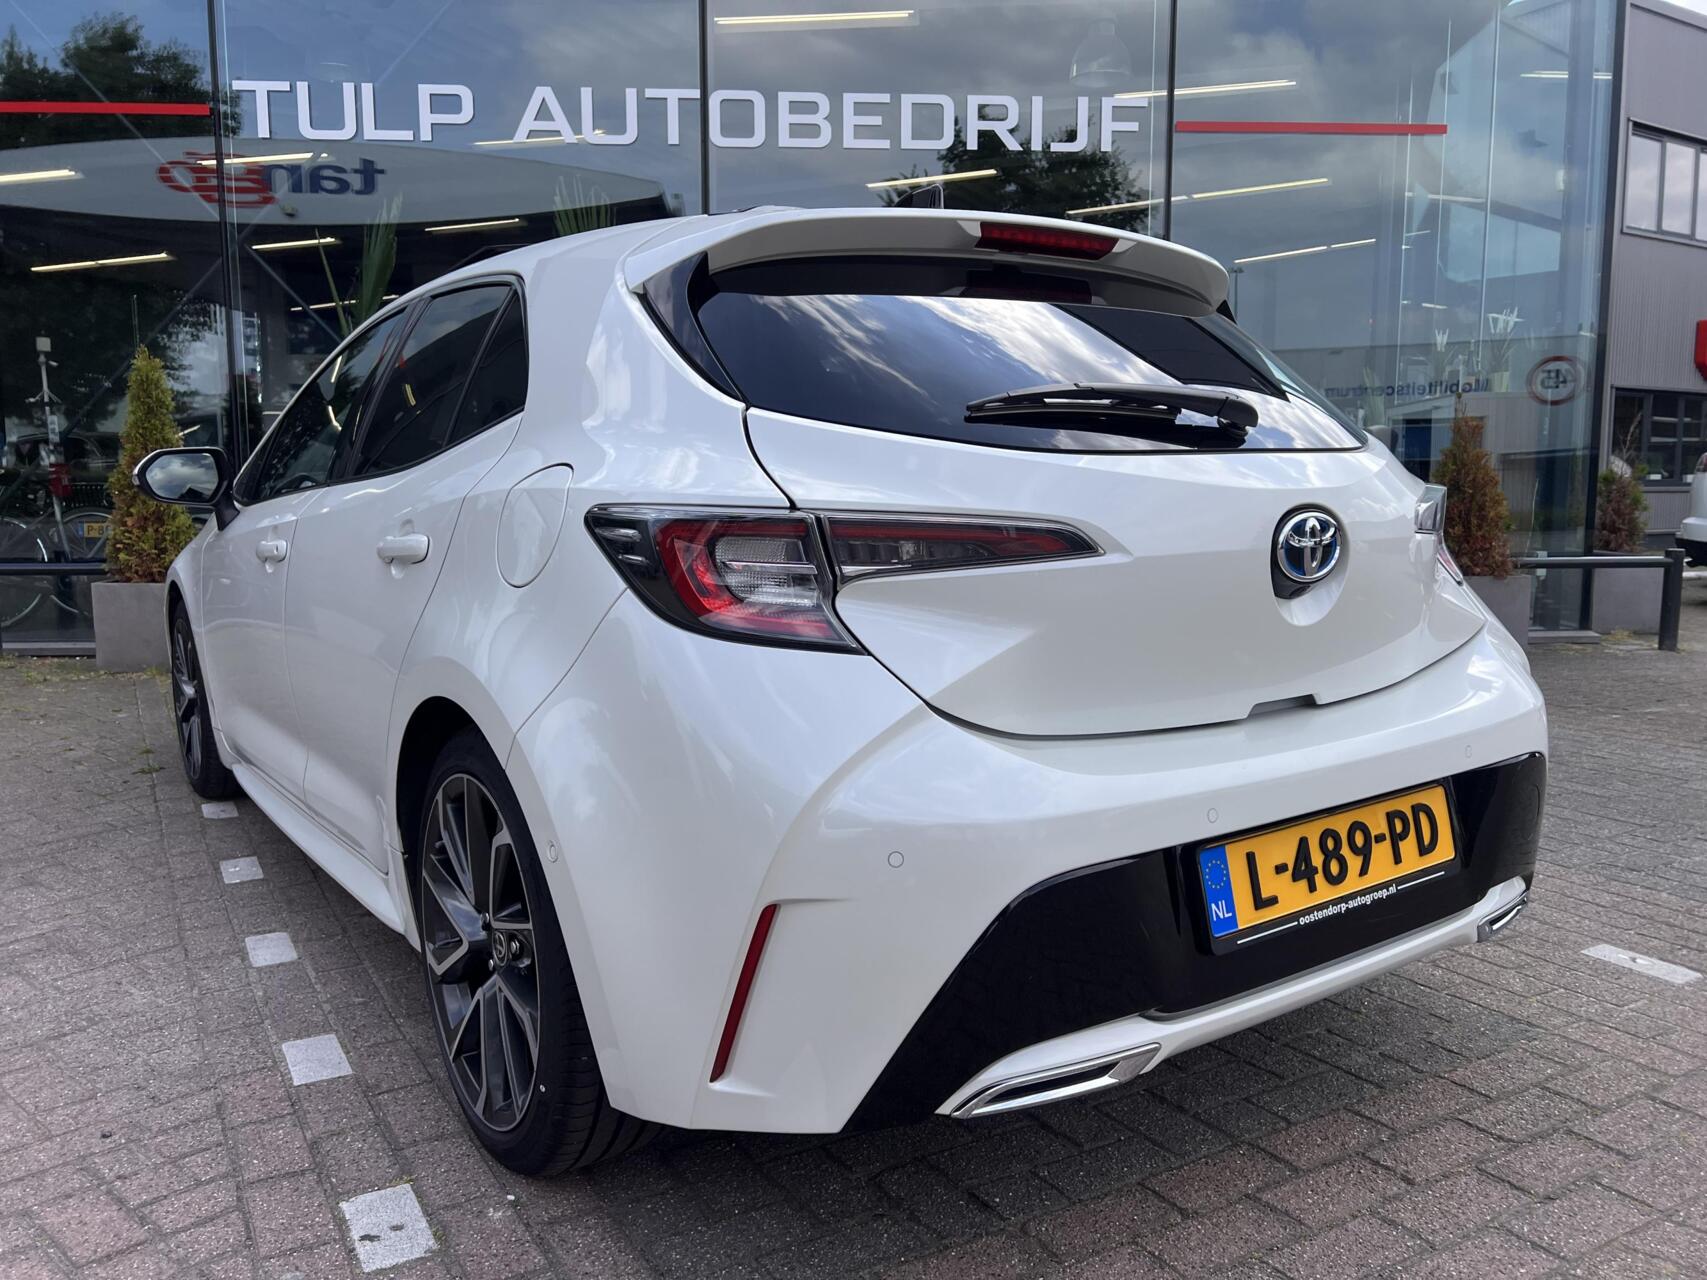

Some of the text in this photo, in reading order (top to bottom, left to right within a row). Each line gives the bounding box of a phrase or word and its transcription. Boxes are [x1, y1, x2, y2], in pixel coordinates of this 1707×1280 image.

[232, 80, 1149, 153] TULP AUTOBEDRIJF
[1245, 802, 1439, 912] L-489-PD
[1211, 900, 1233, 921] NL
[1298, 883, 1397, 926] oostendorp-autogroep.nl
